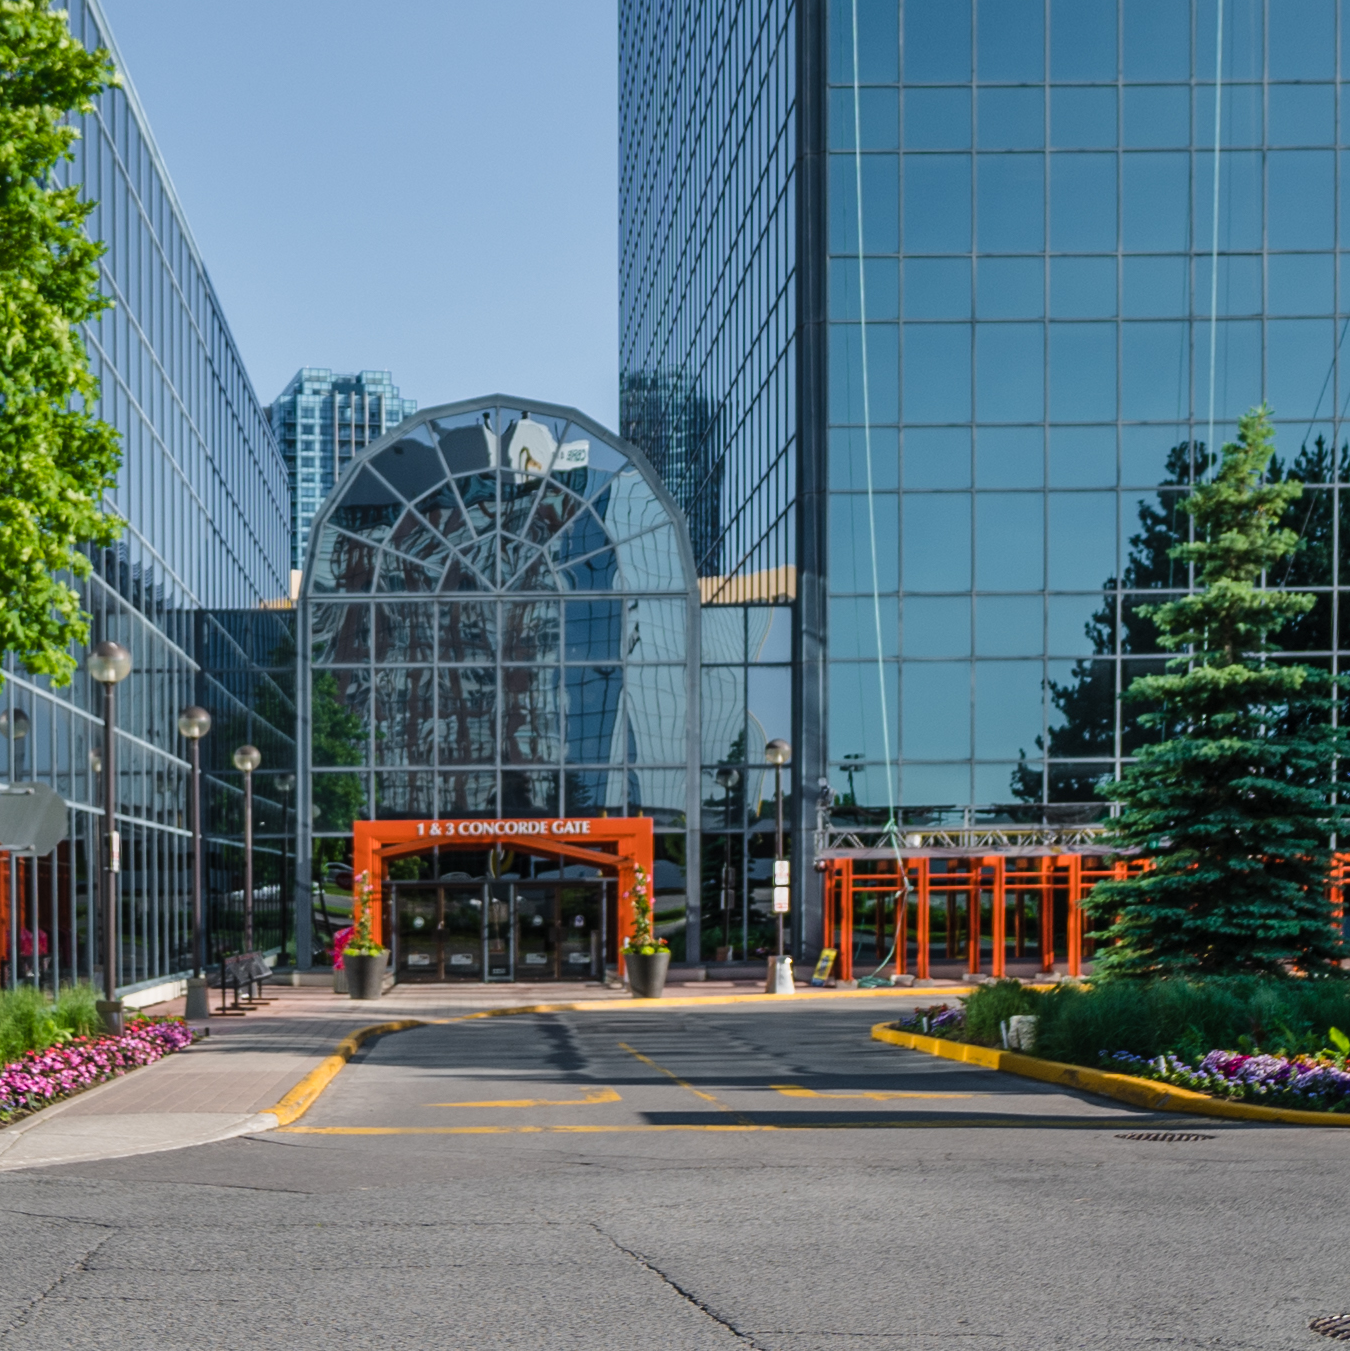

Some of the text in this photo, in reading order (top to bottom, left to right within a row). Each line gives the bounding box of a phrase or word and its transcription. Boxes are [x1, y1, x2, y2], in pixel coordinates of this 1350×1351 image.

[417, 820, 591, 836] 1 & 3 CONCORDE GATE
